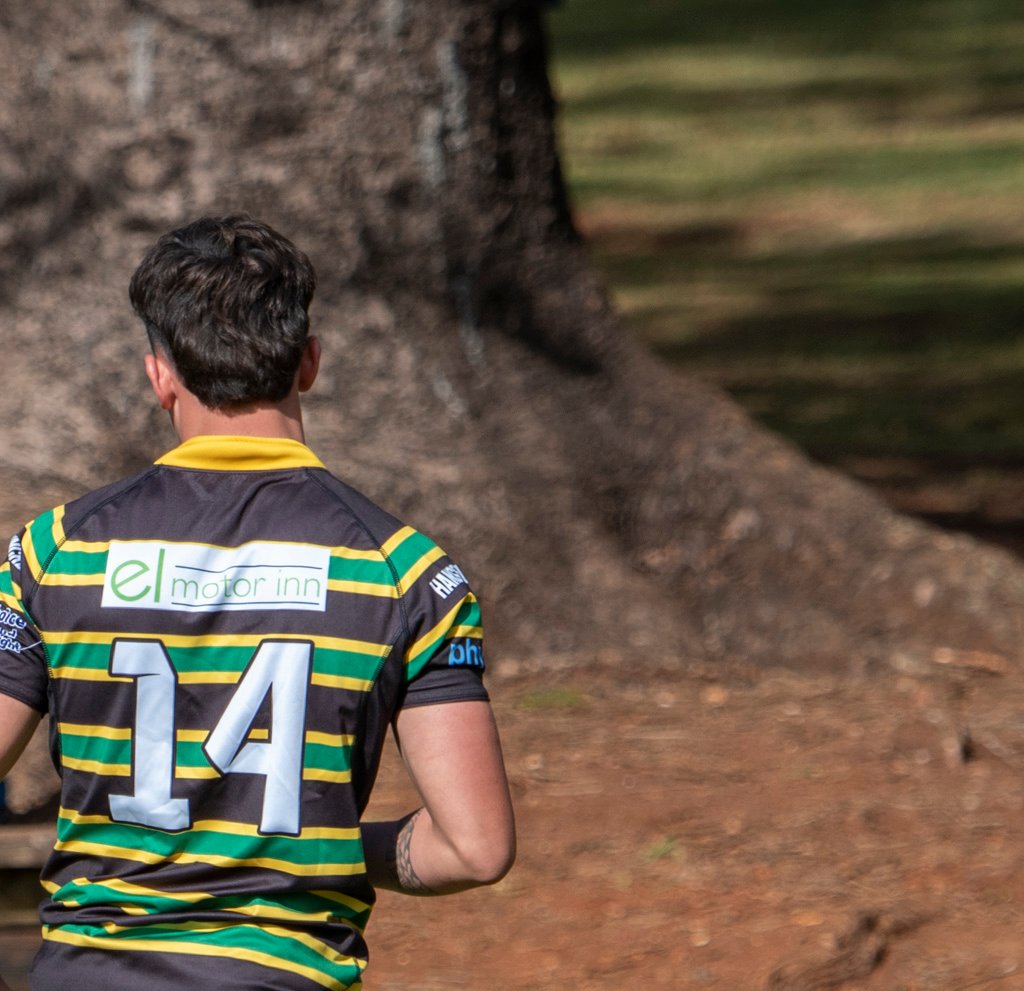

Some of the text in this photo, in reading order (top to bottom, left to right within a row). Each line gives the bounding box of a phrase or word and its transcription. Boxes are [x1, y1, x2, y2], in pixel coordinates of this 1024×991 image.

[111, 549, 320, 602] el motor inn
[108, 638, 314, 836] 14
